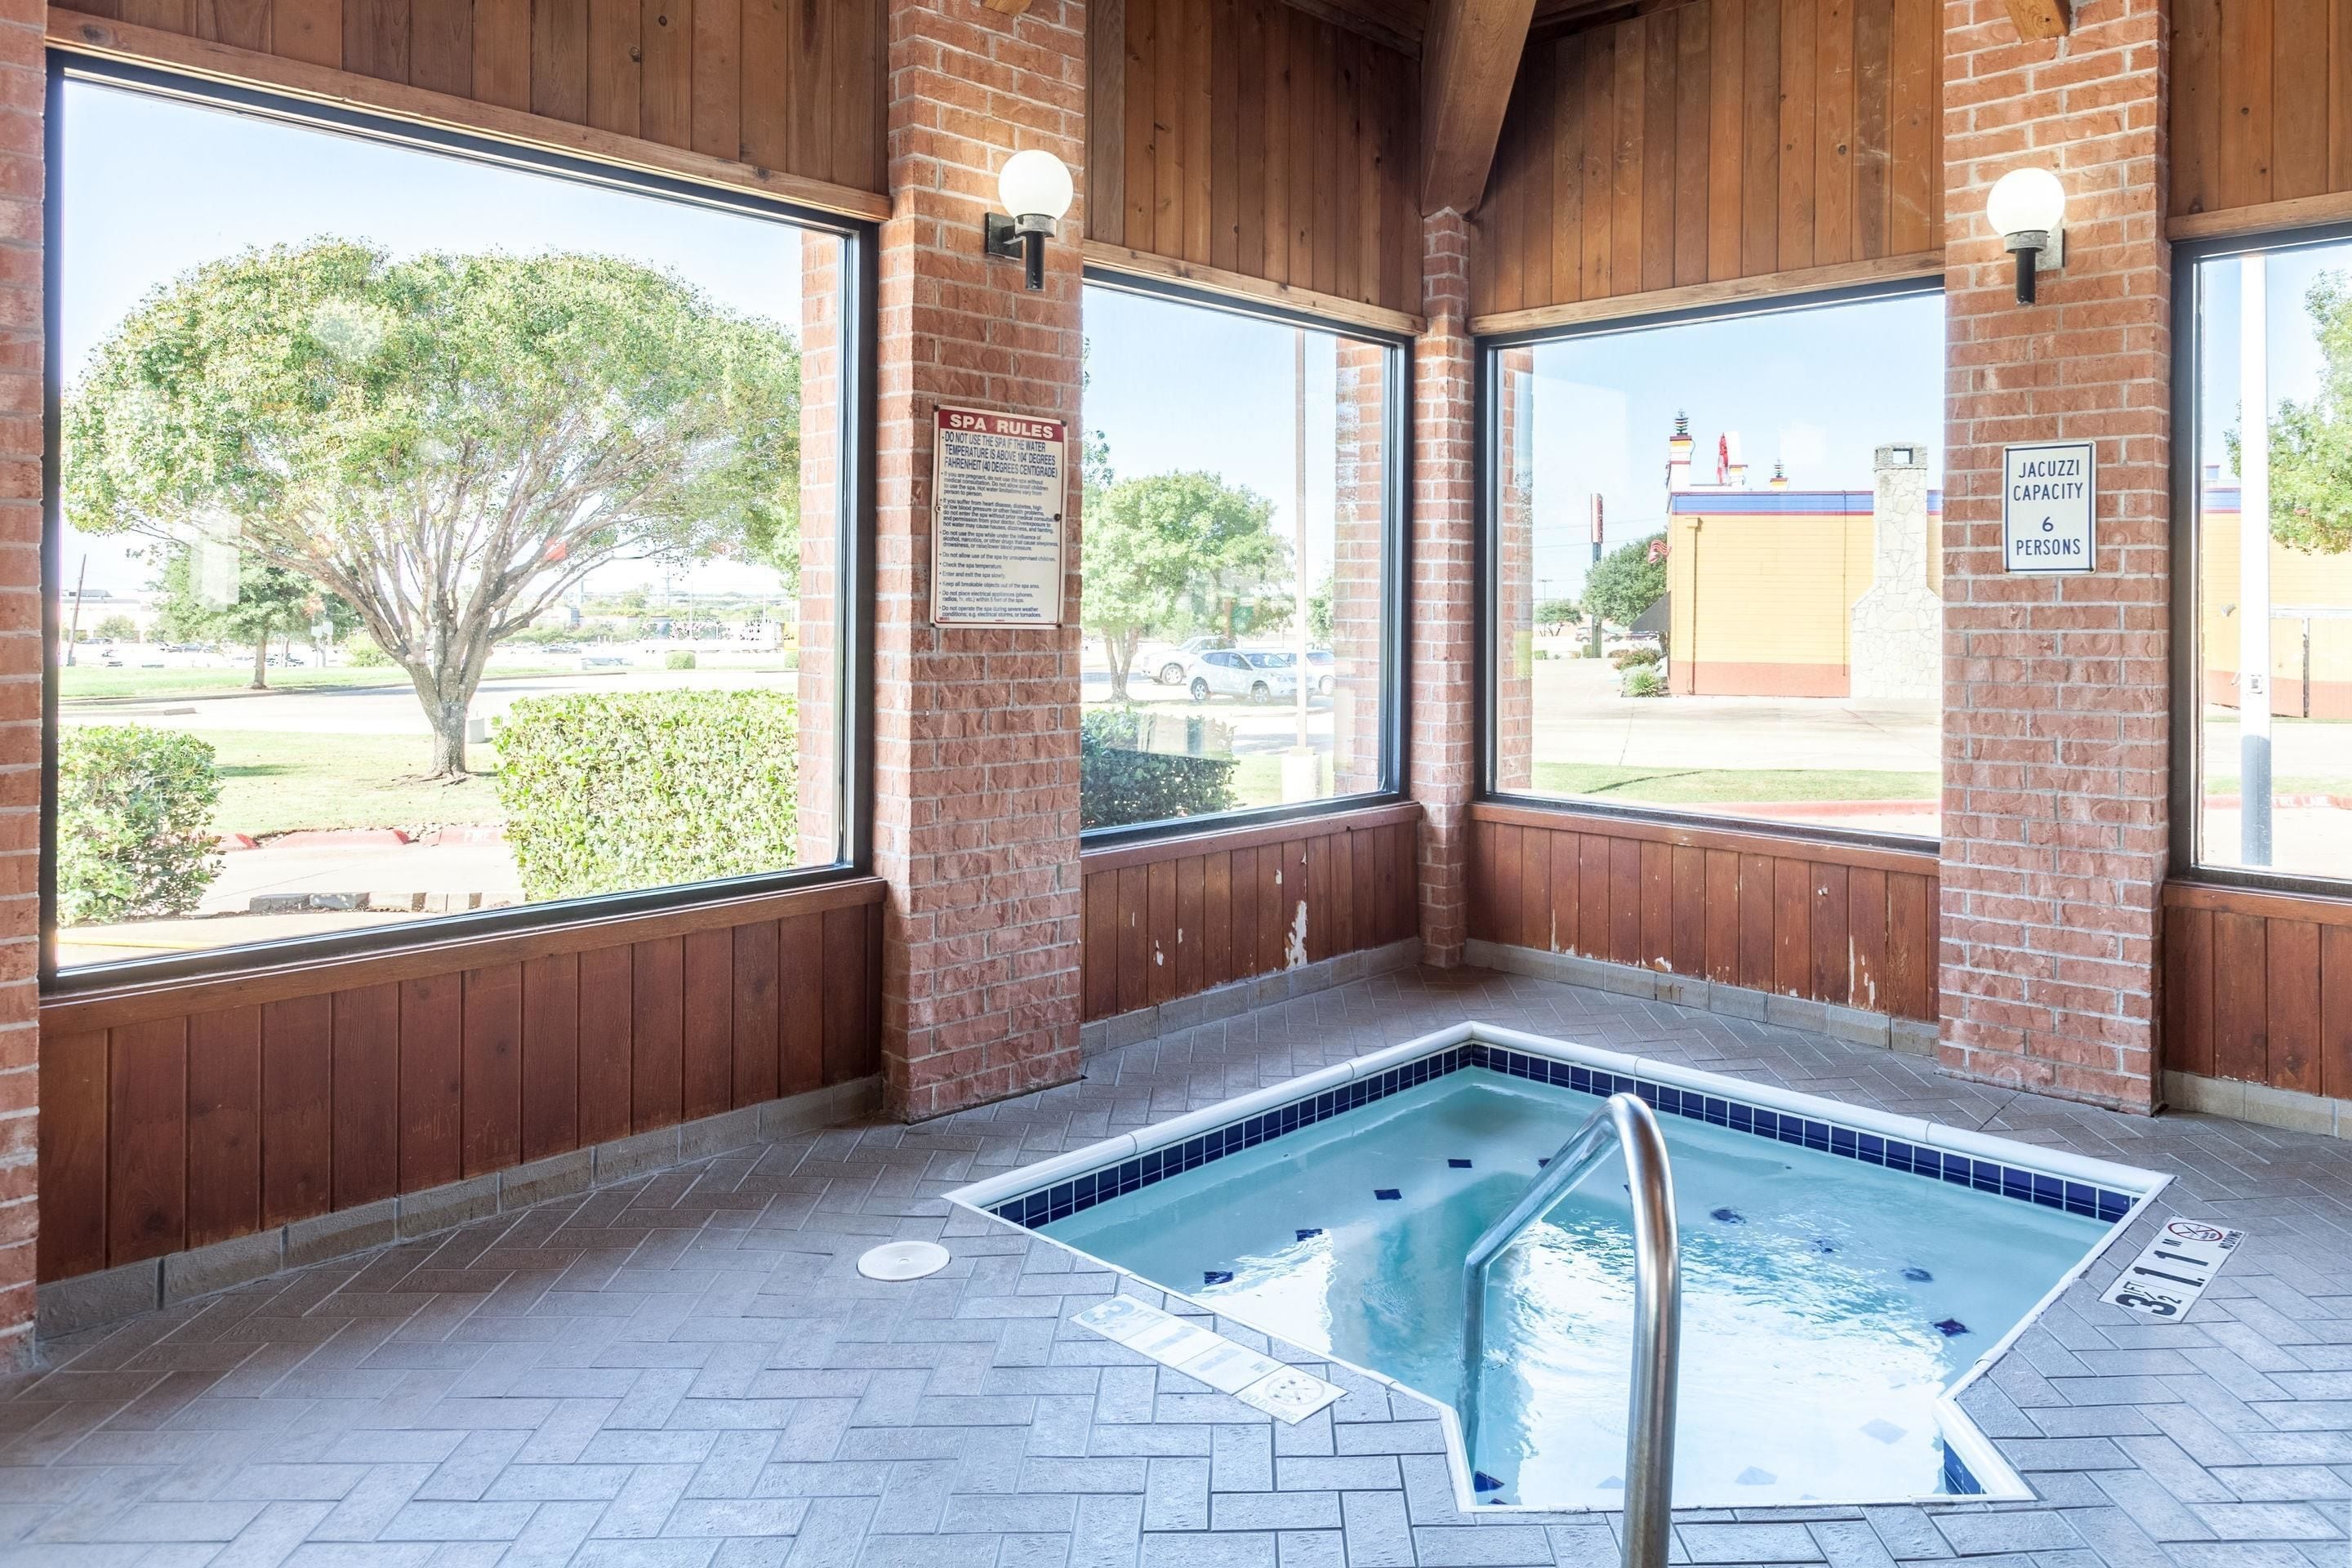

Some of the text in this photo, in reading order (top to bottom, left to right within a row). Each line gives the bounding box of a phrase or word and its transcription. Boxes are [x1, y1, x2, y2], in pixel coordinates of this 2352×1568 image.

[950, 414, 1053, 438] SPA RULES
[945, 431, 1045, 452] DO NOT USE THE SPA IF THE WATER
[945, 444, 988, 458] TEMPERATURE
[990, 448, 995, 459] IS
[996, 449, 1016, 461] ABOVE
[1028, 452, 1055, 465] DEGREES
[944, 457, 1058, 479] FAHRENHEIT (40 DEGREES CENTIGRADE)
[2019, 460, 2079, 478] JACUZZI
[2014, 483, 2083, 501] CAPACITY
[2042, 516, 2054, 532] 6
[2016, 538, 2081, 556] PERSONS
[464, 829, 492, 842] FIRE
[2162, 1238, 2182, 1247] M
[1080, 1299, 1134, 1325] 3
[2116, 1294, 2176, 1316] 3
